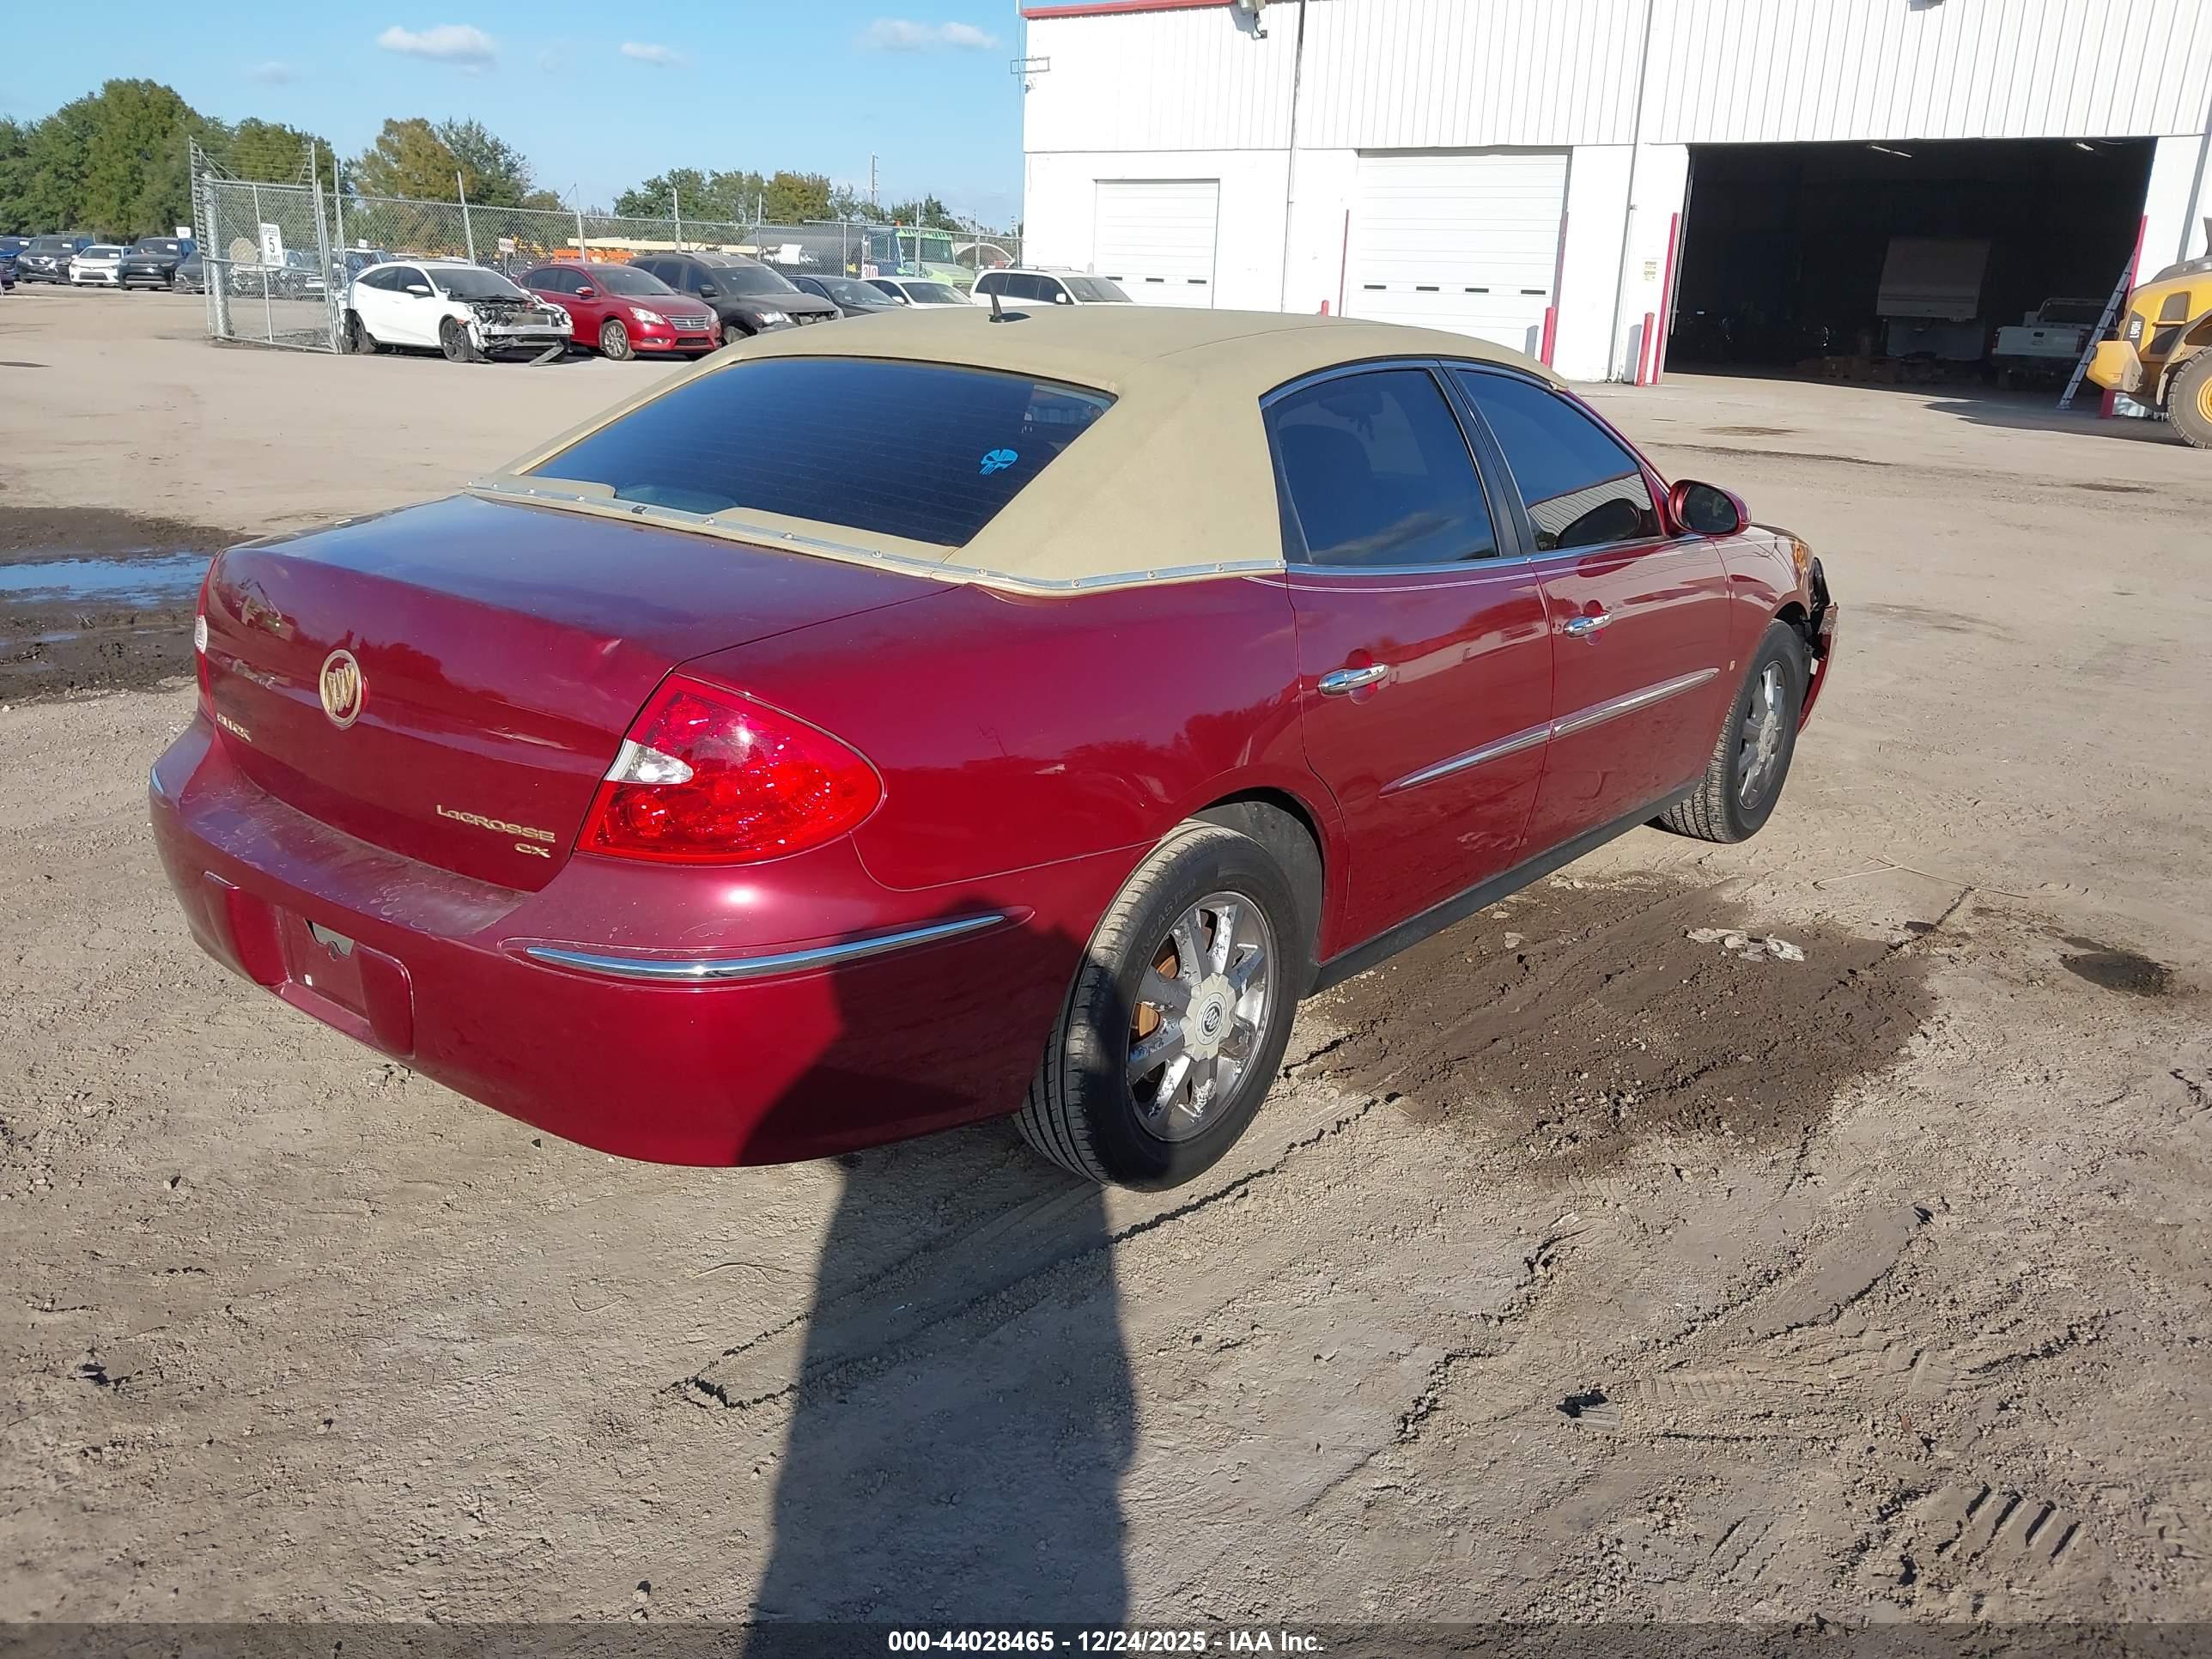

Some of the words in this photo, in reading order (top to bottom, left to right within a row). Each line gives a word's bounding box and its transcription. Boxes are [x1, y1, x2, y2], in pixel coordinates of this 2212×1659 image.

[262, 227, 278, 237] SPEED
[268, 237, 276, 253] 5
[266, 254, 282, 264] LIMIT
[2130, 320, 2142, 338] L90H
[514, 842, 551, 859] CX
